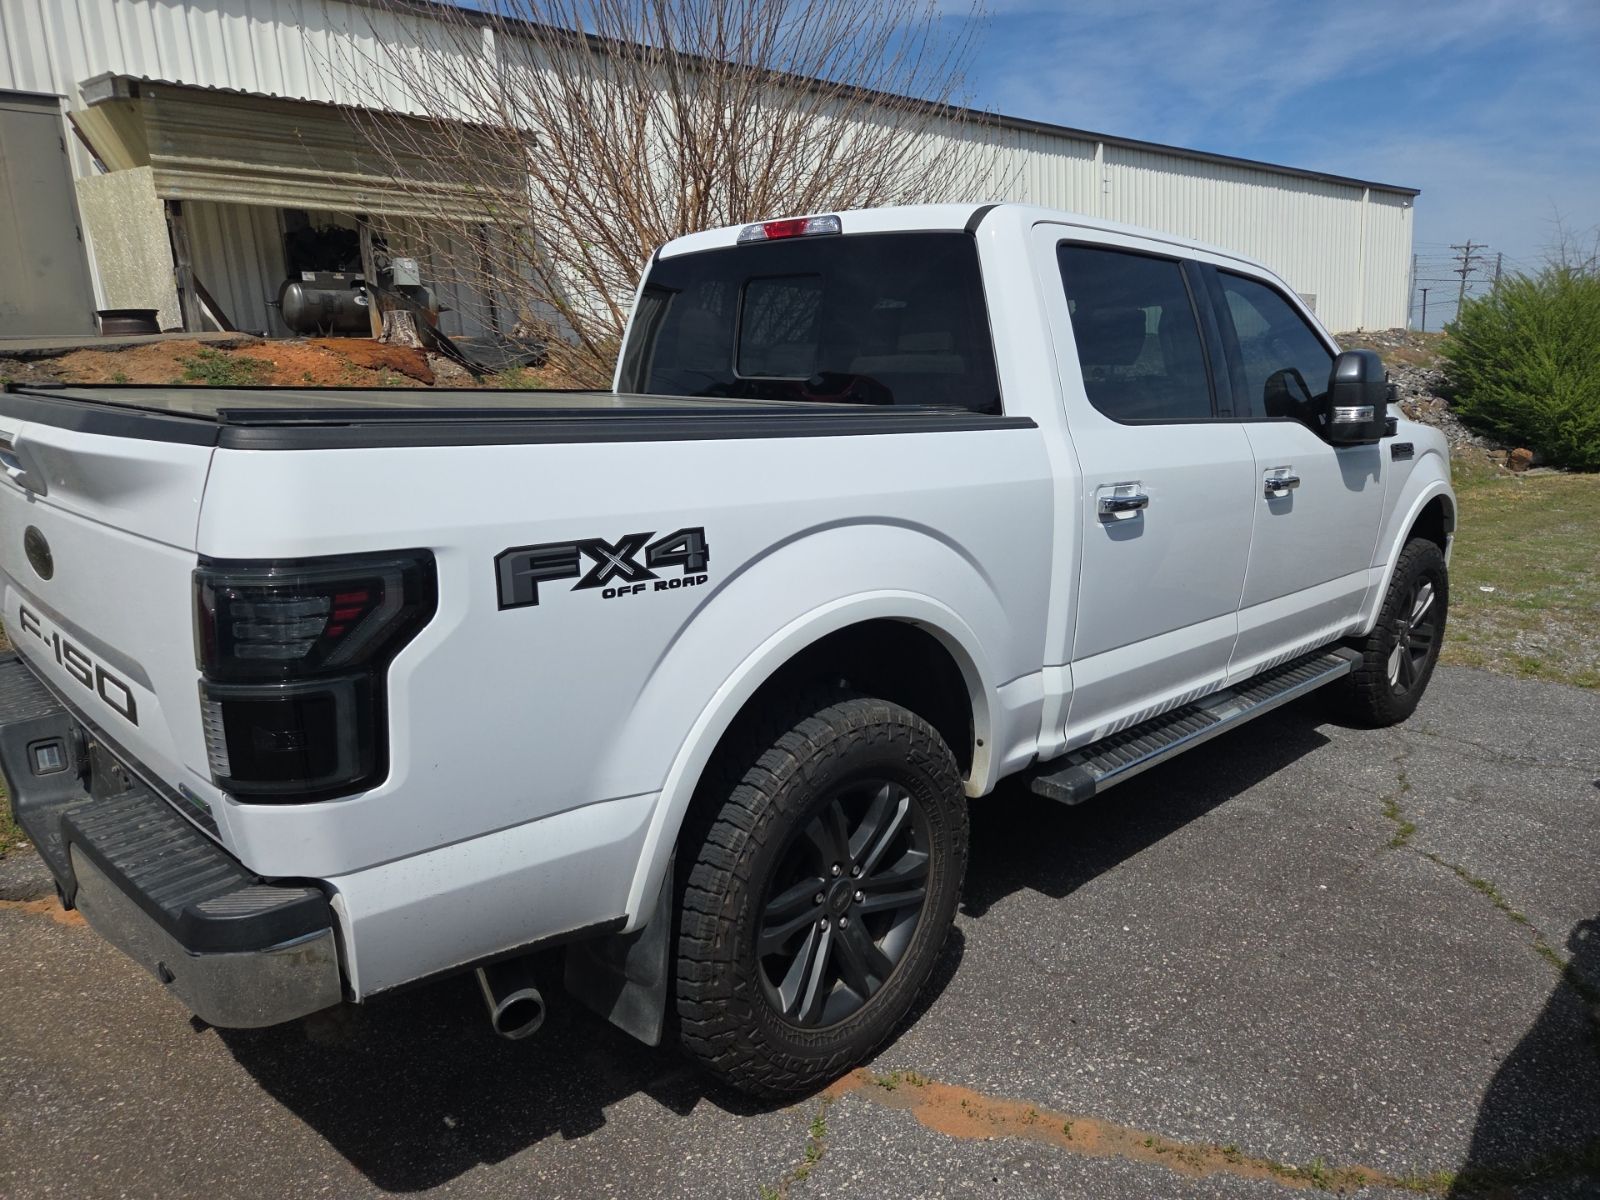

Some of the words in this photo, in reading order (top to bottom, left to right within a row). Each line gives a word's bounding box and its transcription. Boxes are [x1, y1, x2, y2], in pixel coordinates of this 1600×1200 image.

[494, 527, 709, 611] FX4
[602, 583, 646, 599] OFF
[654, 575, 708, 592] ROAD
[20, 604, 139, 727] F-150
